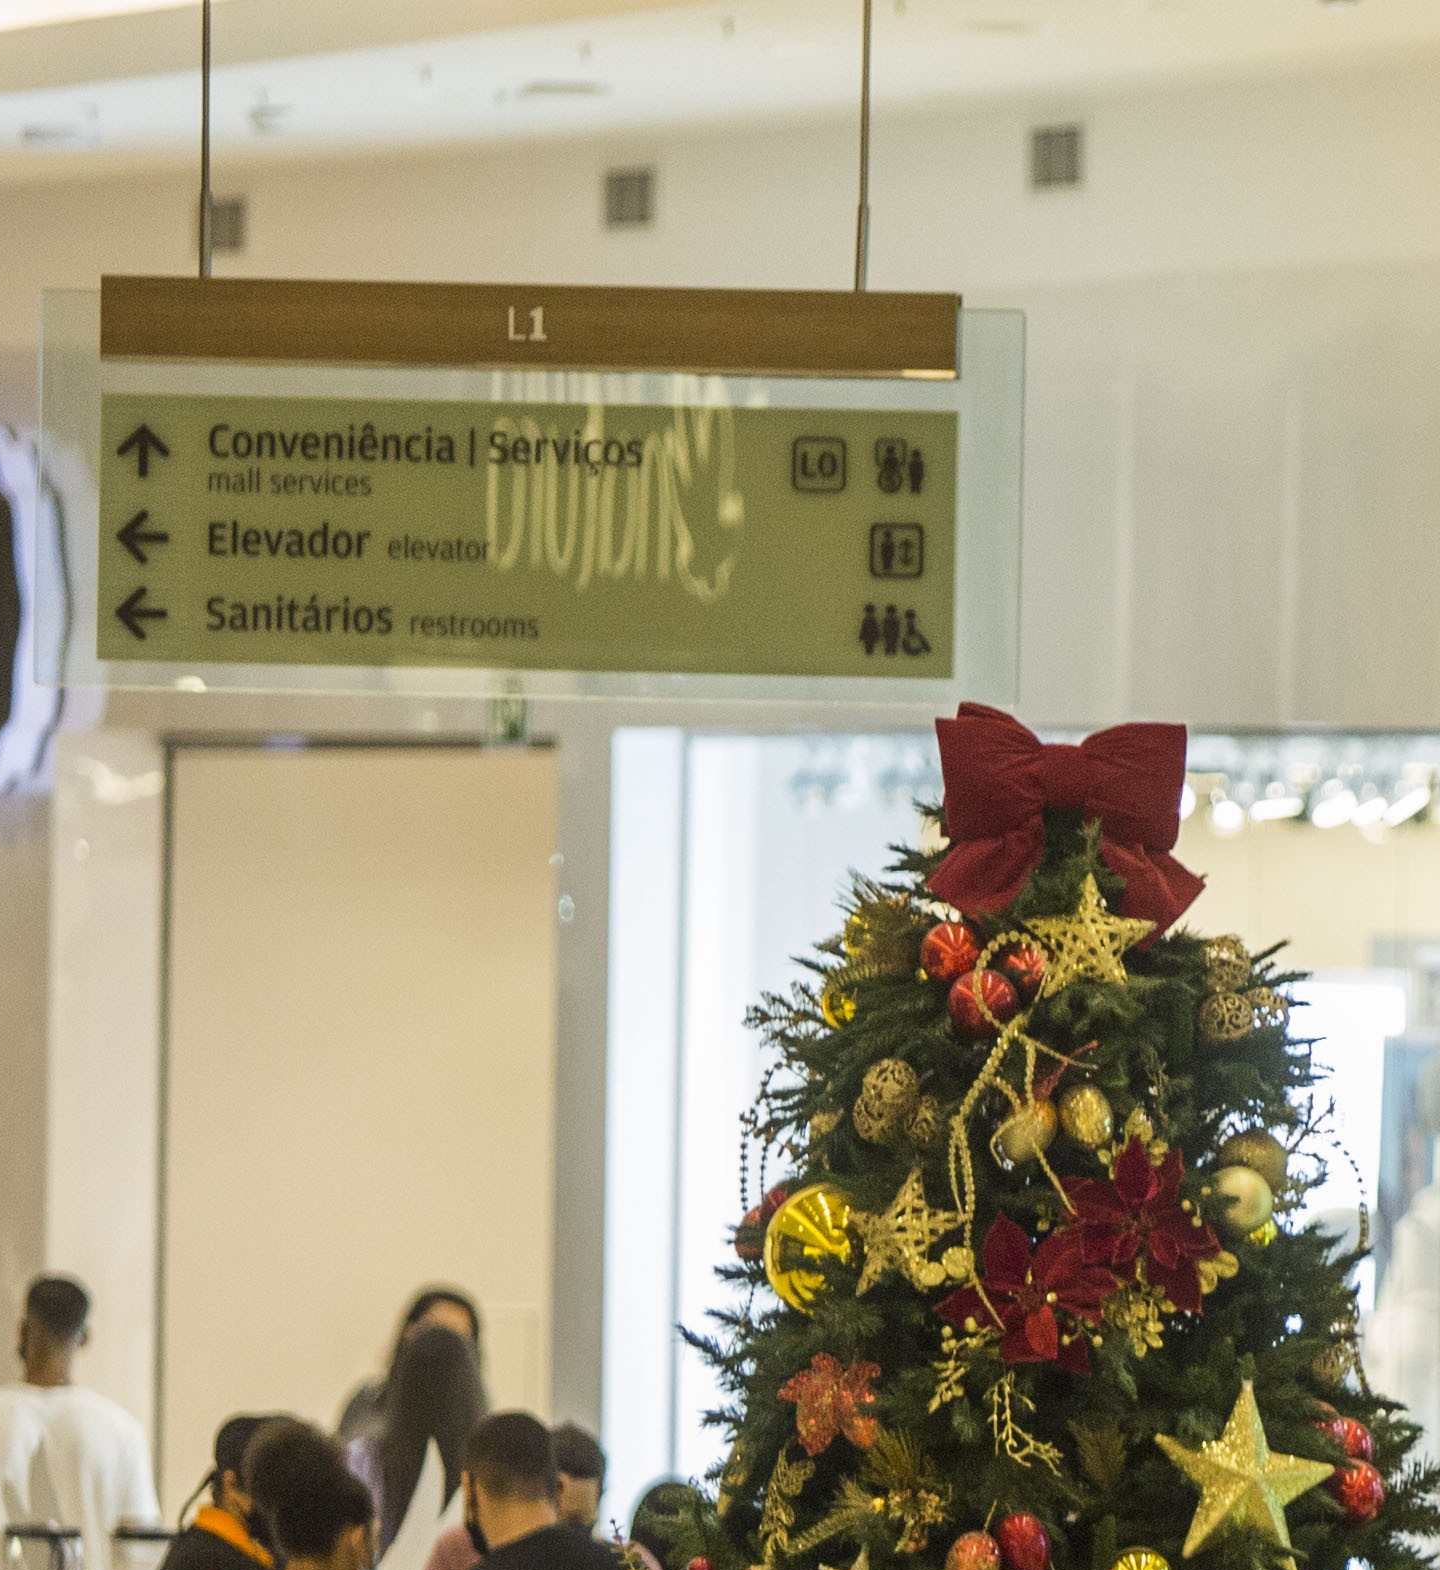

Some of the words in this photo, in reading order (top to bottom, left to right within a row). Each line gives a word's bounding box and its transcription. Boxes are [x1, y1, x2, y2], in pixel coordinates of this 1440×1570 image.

[507, 305, 548, 341] L1
[208, 422, 456, 464] Conveniência
[489, 428, 644, 475] Serviços
[208, 468, 261, 495] mall
[270, 470, 373, 498] services
[208, 520, 372, 559] Elevador
[387, 533, 491, 563] elevator
[206, 594, 394, 636] Sanitários
[409, 611, 540, 640] restrooms
